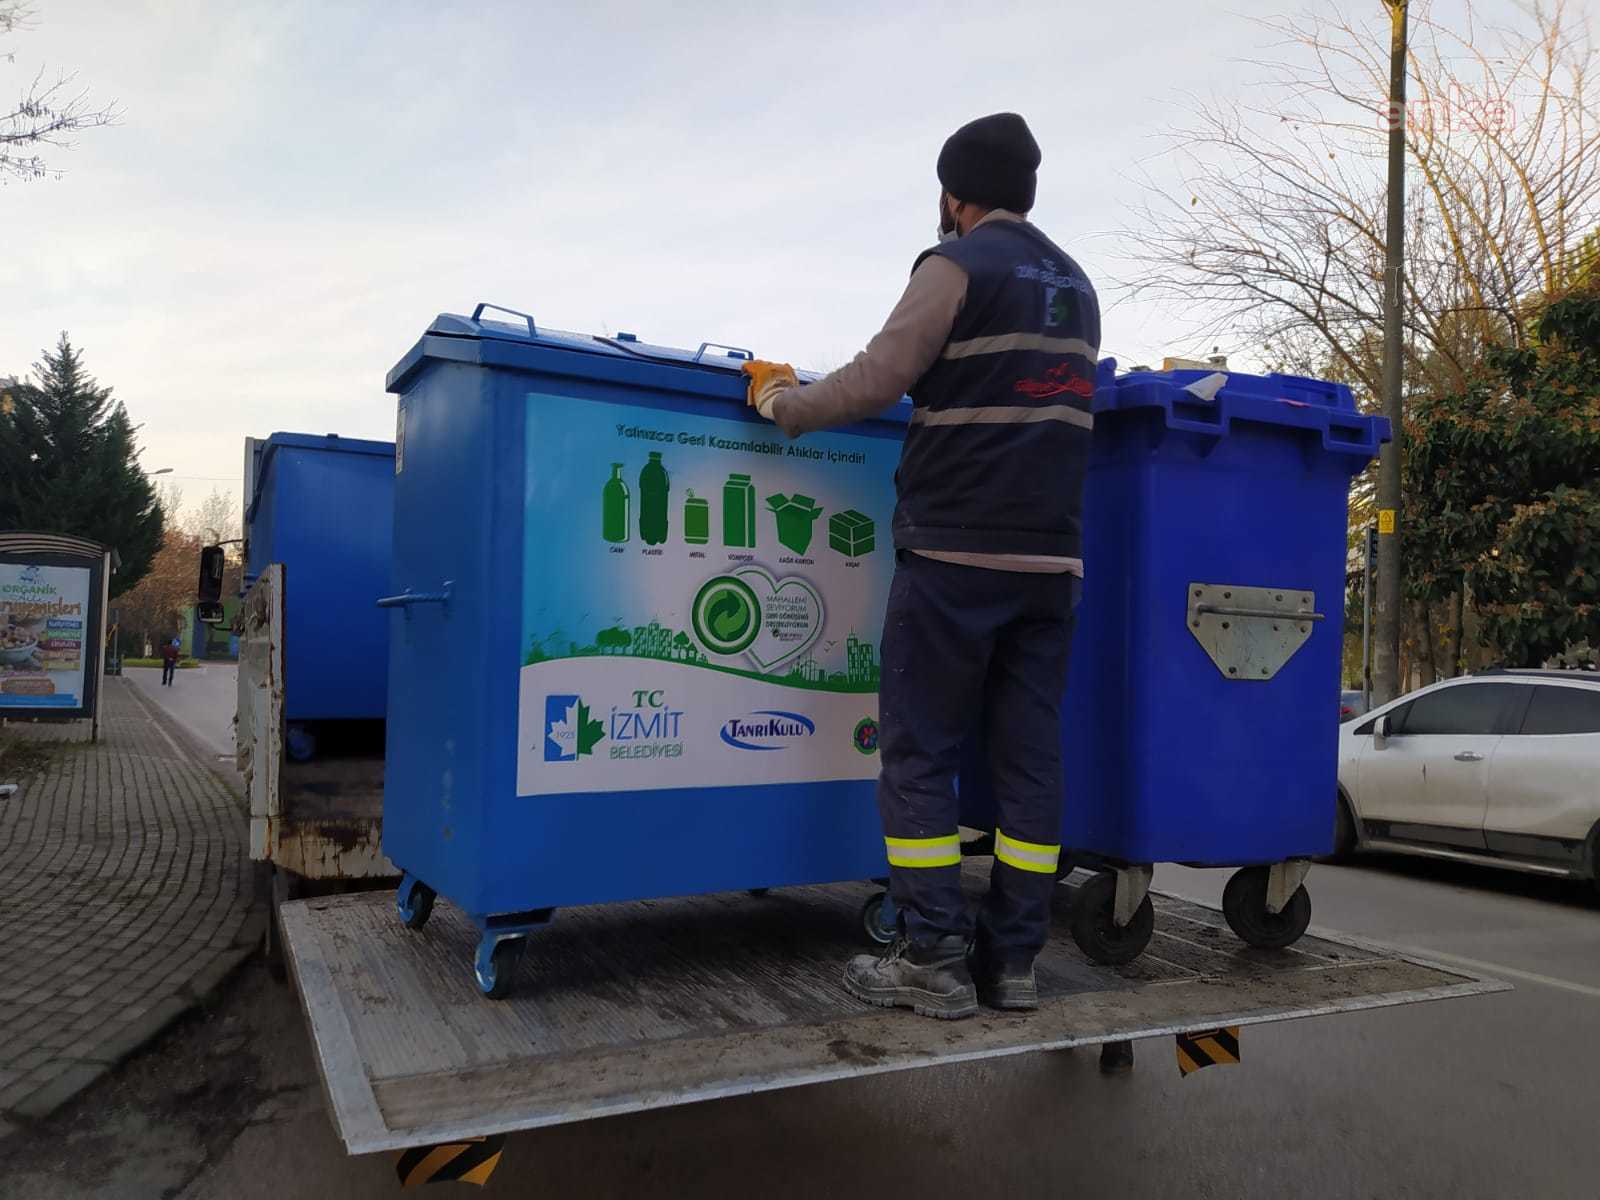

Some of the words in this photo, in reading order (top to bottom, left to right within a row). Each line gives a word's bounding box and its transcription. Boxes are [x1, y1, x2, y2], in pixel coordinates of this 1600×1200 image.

[678, 432, 706, 447] Geri
[708, 432, 784, 457] Kazanılabilir
[787, 445, 823, 460] Atıklar
[632, 690, 665, 708] TC
[609, 705, 684, 740] İZMİT
[609, 741, 684, 760] BELEDİYESİ
